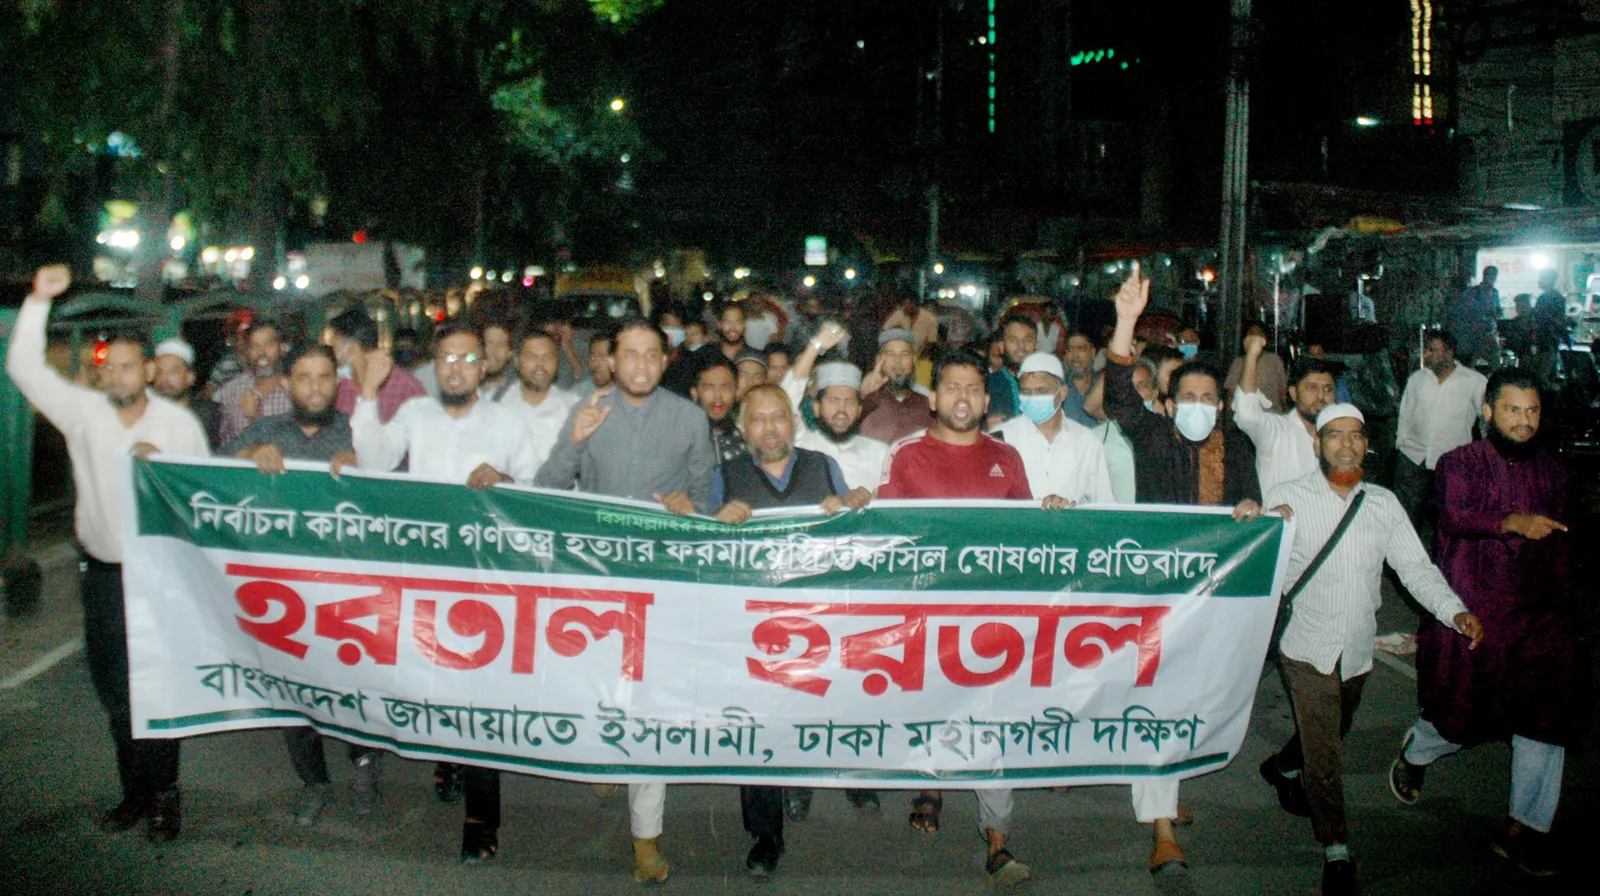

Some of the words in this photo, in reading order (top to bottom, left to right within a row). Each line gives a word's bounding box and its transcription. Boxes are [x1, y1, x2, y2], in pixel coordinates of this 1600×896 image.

[190, 491, 297, 538] নির্বাচন
[302, 502, 450, 549] কমিশনের
[459, 521, 556, 561] গণতন্ত্র
[561, 532, 656, 564] হত্যার
[957, 542, 1079, 576] ঘোষণার
[1087, 538, 1219, 580] প্রতিবাদে
[225, 562, 655, 682] হরতাল
[745, 600, 1172, 698] হরতাল
[195, 662, 369, 723] বাংলাদেশ
[380, 698, 584, 748] জামায়াতে
[595, 700, 774, 763] ইসলামী,
[792, 718, 893, 758] ঢাকা
[903, 706, 1079, 762] মহানগরী
[1089, 704, 1206, 755] দক্ষিণ
